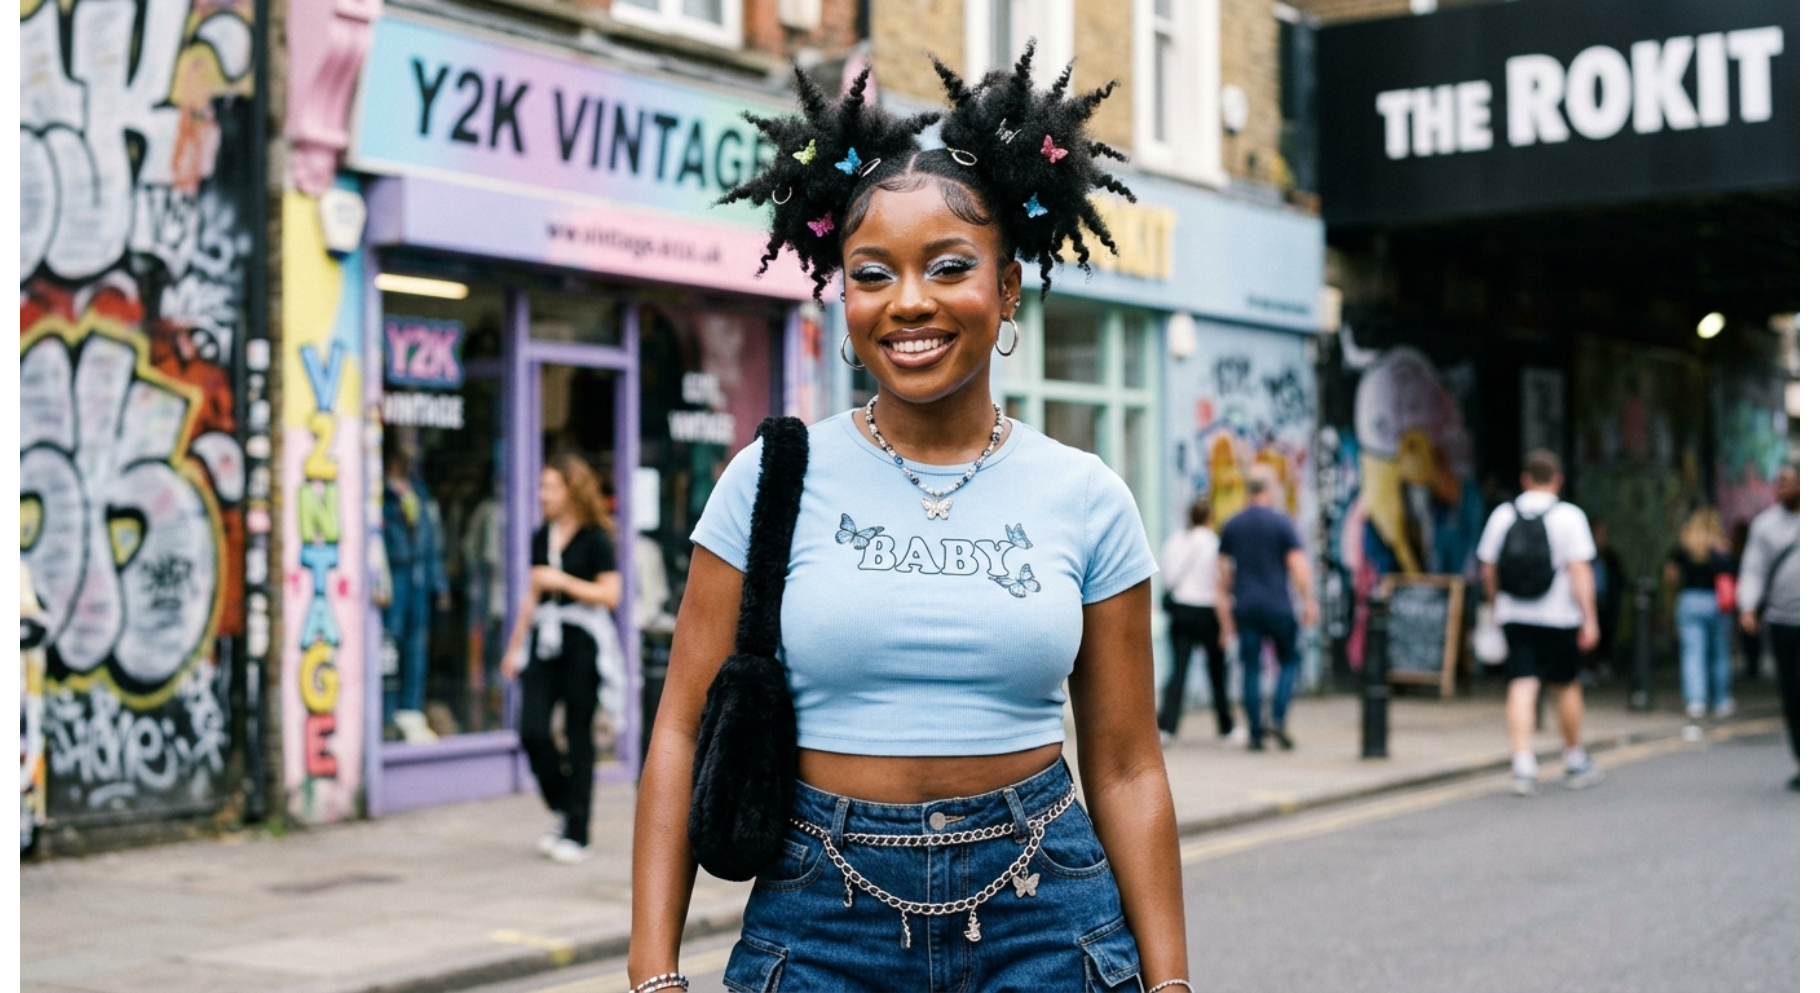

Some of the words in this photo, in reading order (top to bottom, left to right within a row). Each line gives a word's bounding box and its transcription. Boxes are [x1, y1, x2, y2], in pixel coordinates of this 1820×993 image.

[410, 58, 531, 156] Y2K
[1376, 79, 1493, 160] THE
[1506, 25, 1784, 147] ROKIT
[384, 321, 460, 381] Y2K
[857, 534, 1018, 577] BABY
